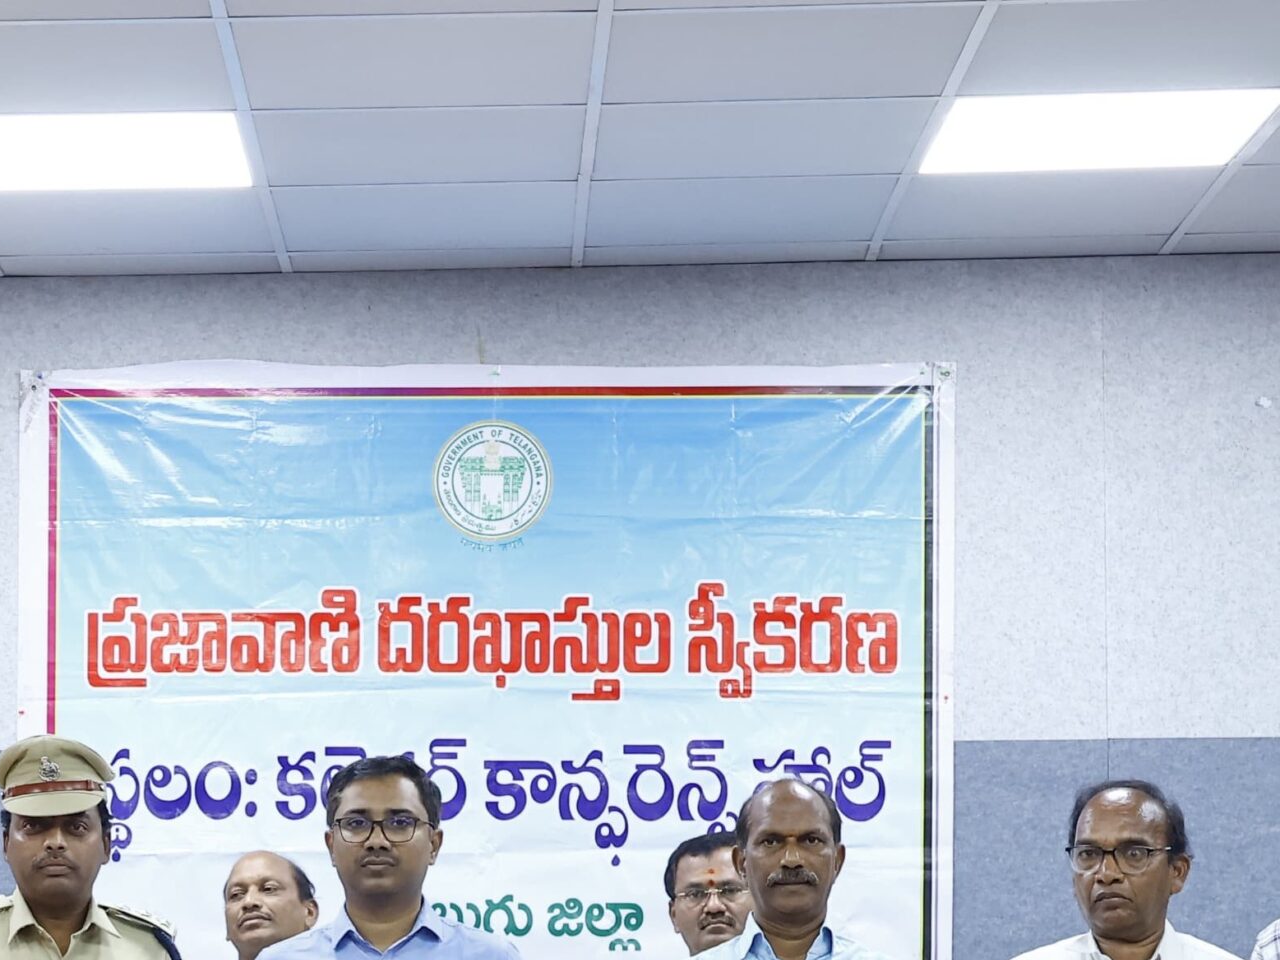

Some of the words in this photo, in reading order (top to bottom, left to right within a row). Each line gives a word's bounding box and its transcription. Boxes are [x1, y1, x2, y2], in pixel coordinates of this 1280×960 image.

[441, 431, 484, 478] GOVERNMENT
[491, 430, 503, 438] OF
[509, 433, 543, 478] TELANGANA
[88, 589, 360, 688] ప్రజావాణి
[377, 597, 670, 700] దరఖాస్తుల
[688, 583, 897, 698] స్వీకరణ
[546, 898, 644, 951] జిల్లా
